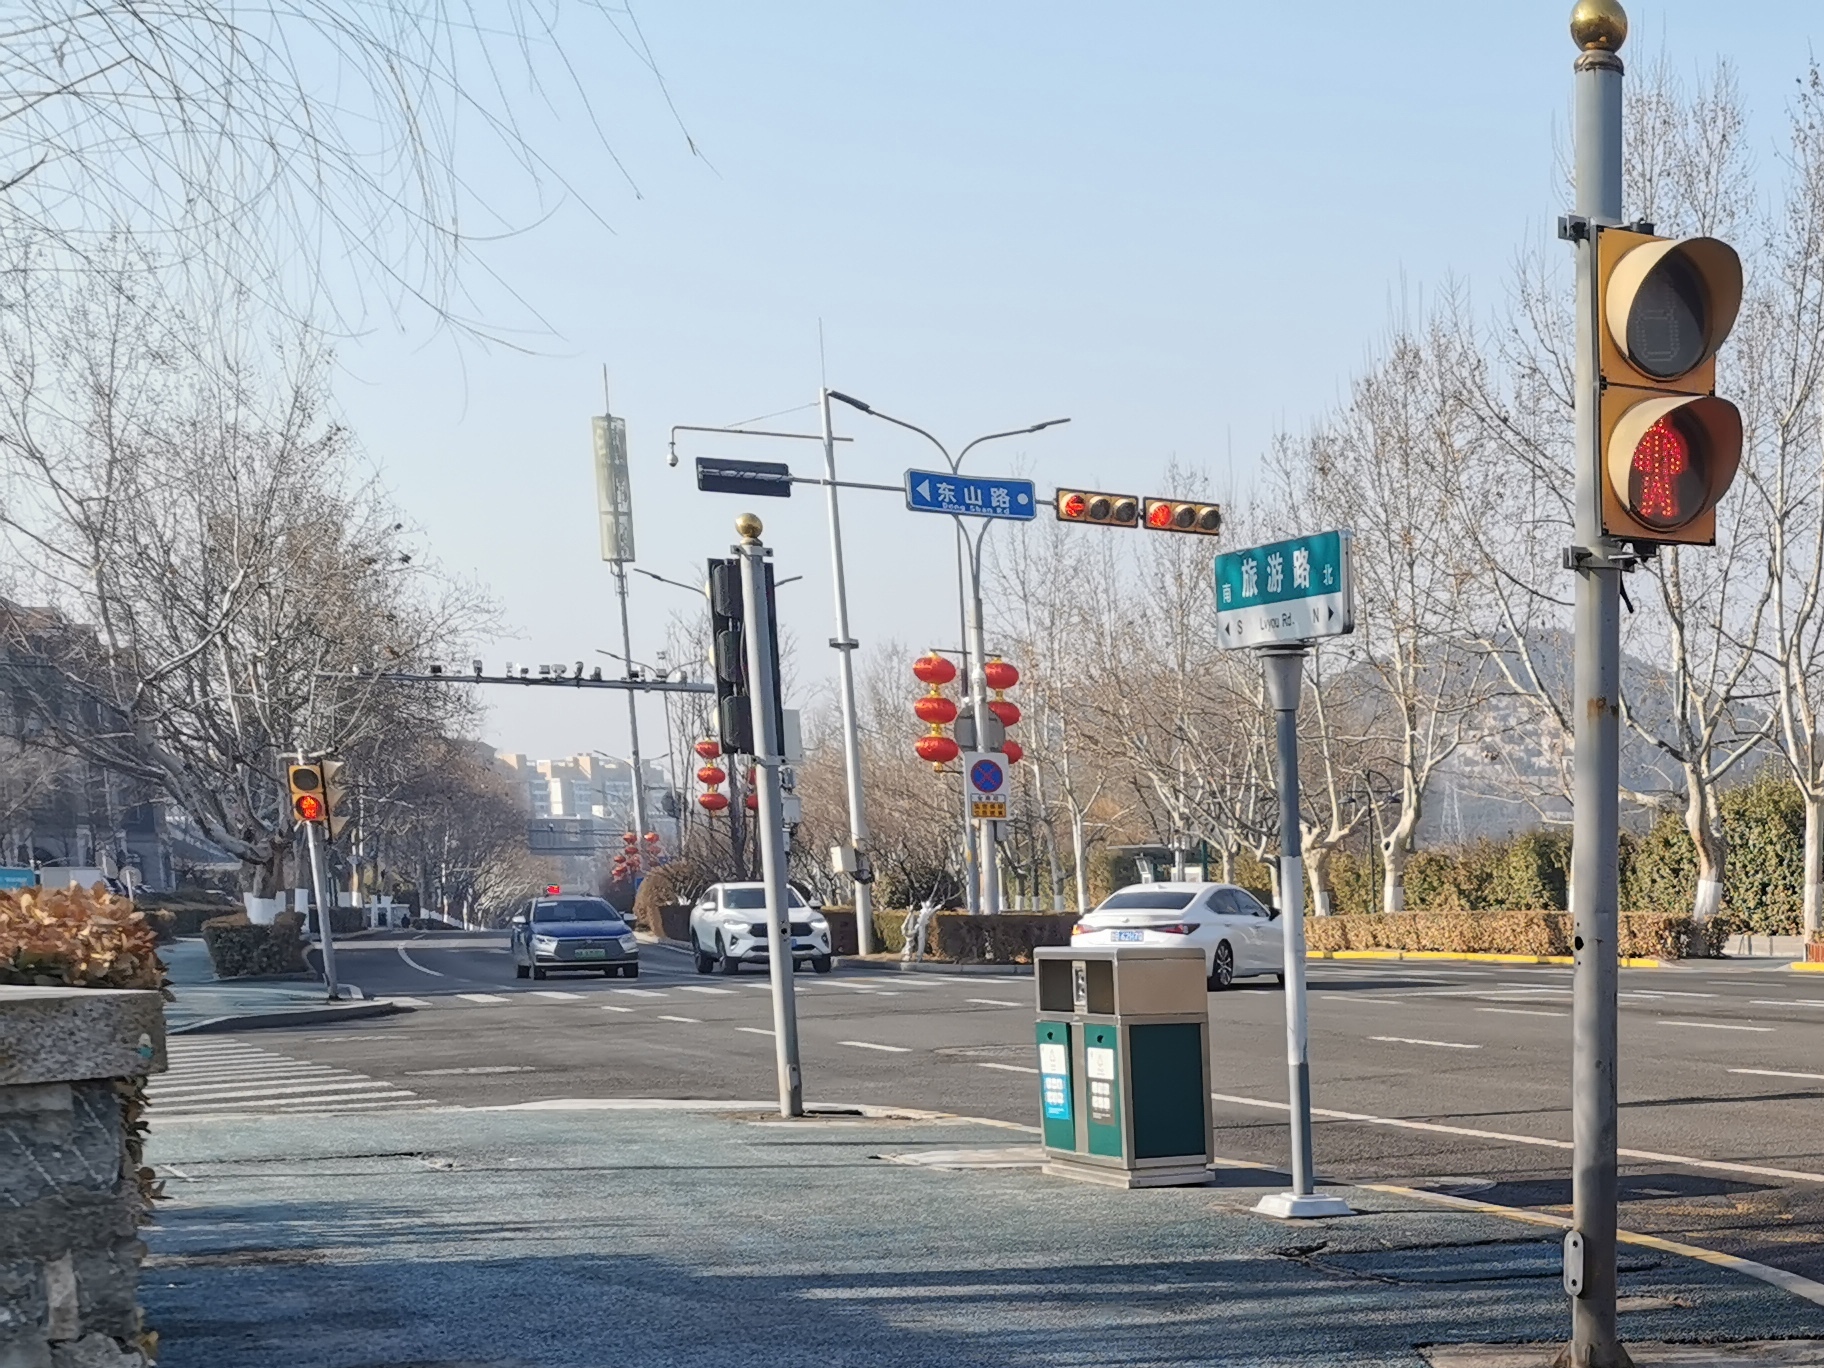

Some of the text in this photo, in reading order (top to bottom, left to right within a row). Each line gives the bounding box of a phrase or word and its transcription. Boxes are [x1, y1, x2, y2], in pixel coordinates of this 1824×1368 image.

[936, 482, 1010, 507] 东山路
[942, 502, 1010, 515] Dong Shan Rd
[1241, 547, 1310, 598] 旅游路
[1323, 564, 1334, 586] 北
[1237, 620, 1243, 635] S
[1313, 607, 1320, 623] N
